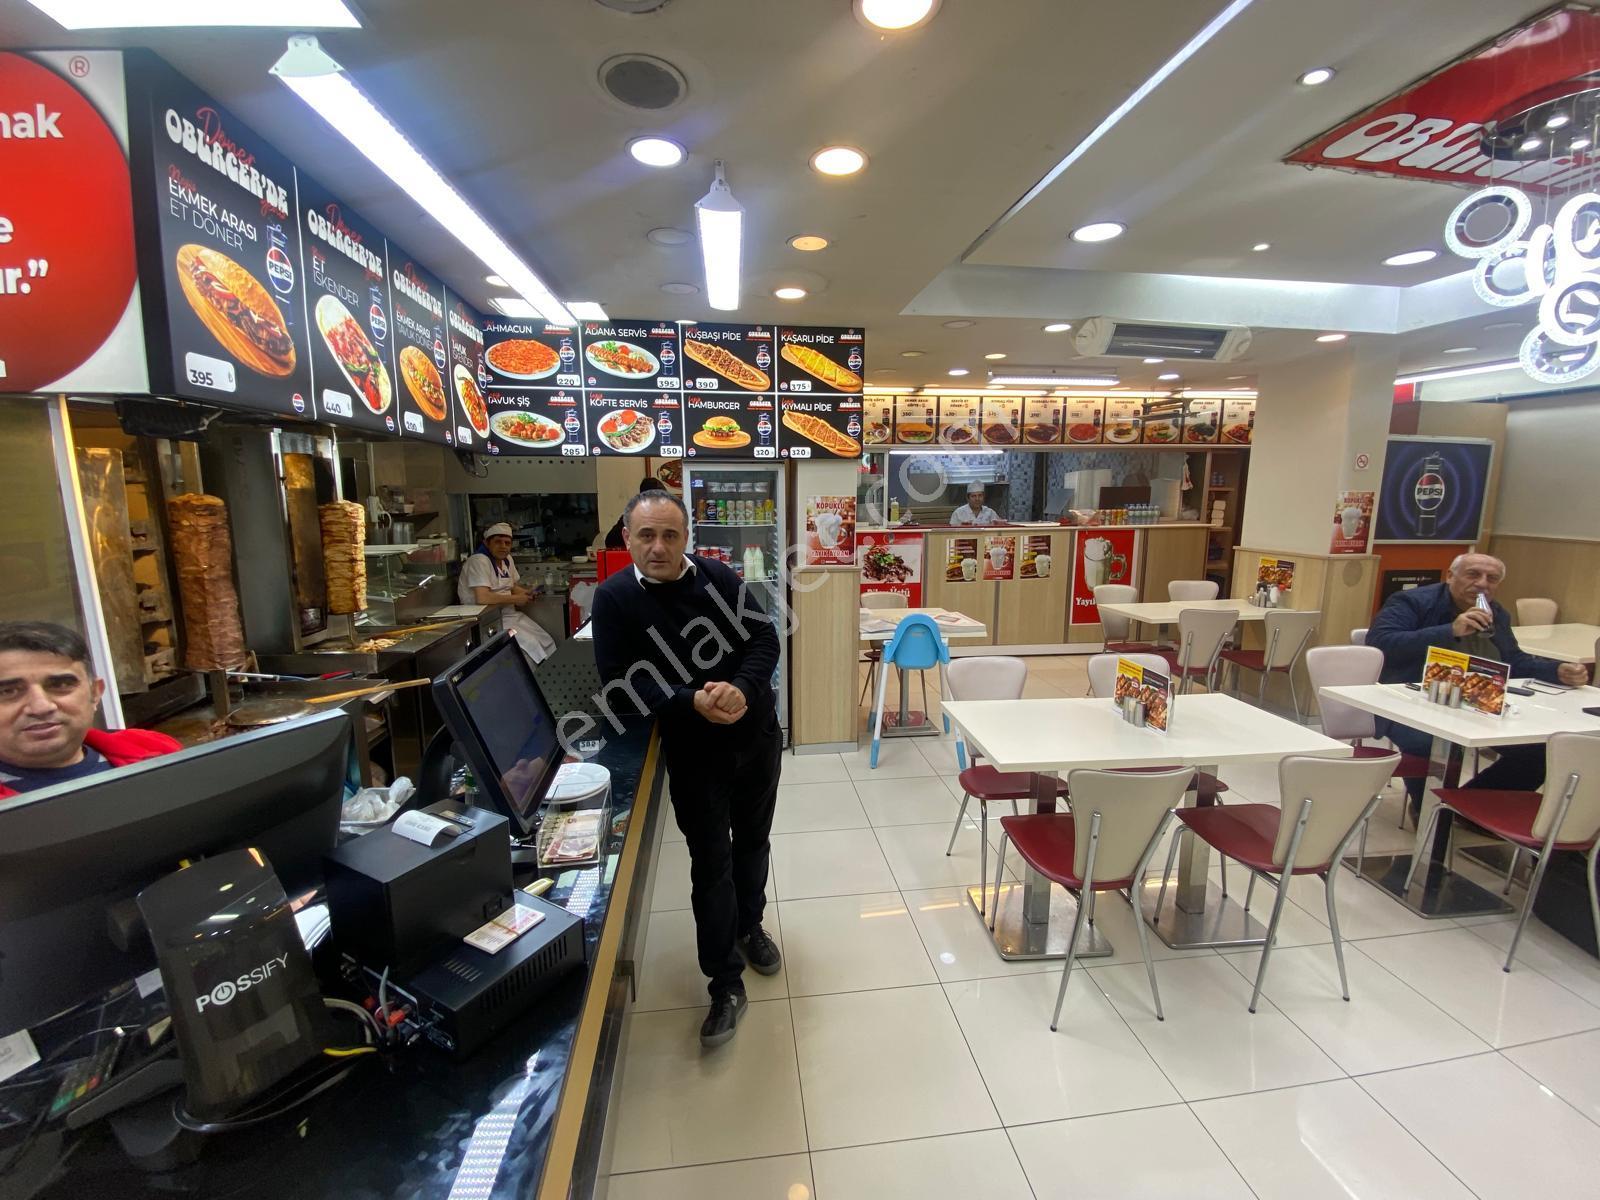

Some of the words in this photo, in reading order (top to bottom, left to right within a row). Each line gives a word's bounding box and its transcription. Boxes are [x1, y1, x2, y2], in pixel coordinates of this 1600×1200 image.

[0, 103, 64, 139] ak
[169, 176, 218, 220] EKMEK
[221, 209, 257, 242] ARASI
[170, 198, 188, 220] ET
[192, 210, 243, 251] DÖNER
[312, 255, 326, 273] ET
[269, 261, 293, 279] PEPSI
[585, 327, 617, 336] ADANA
[618, 328, 647, 338] SERVİS
[685, 331, 720, 342] KUŞBAŞI
[722, 331, 741, 341] PİDE
[781, 334, 814, 344] KAŞARLI
[816, 334, 834, 344] PİDE
[190, 369, 214, 386] 395
[516, 395, 530, 406] ŞİŞ
[619, 398, 648, 408] SERVİS
[688, 401, 740, 410] HAMBURGER
[325, 403, 342, 414] 440
[781, 402, 812, 411] KIYMALI
[814, 402, 832, 411] PİDE
[1417, 487, 1443, 496] PEPSI
[195, 952, 289, 1013] POSSIFY
